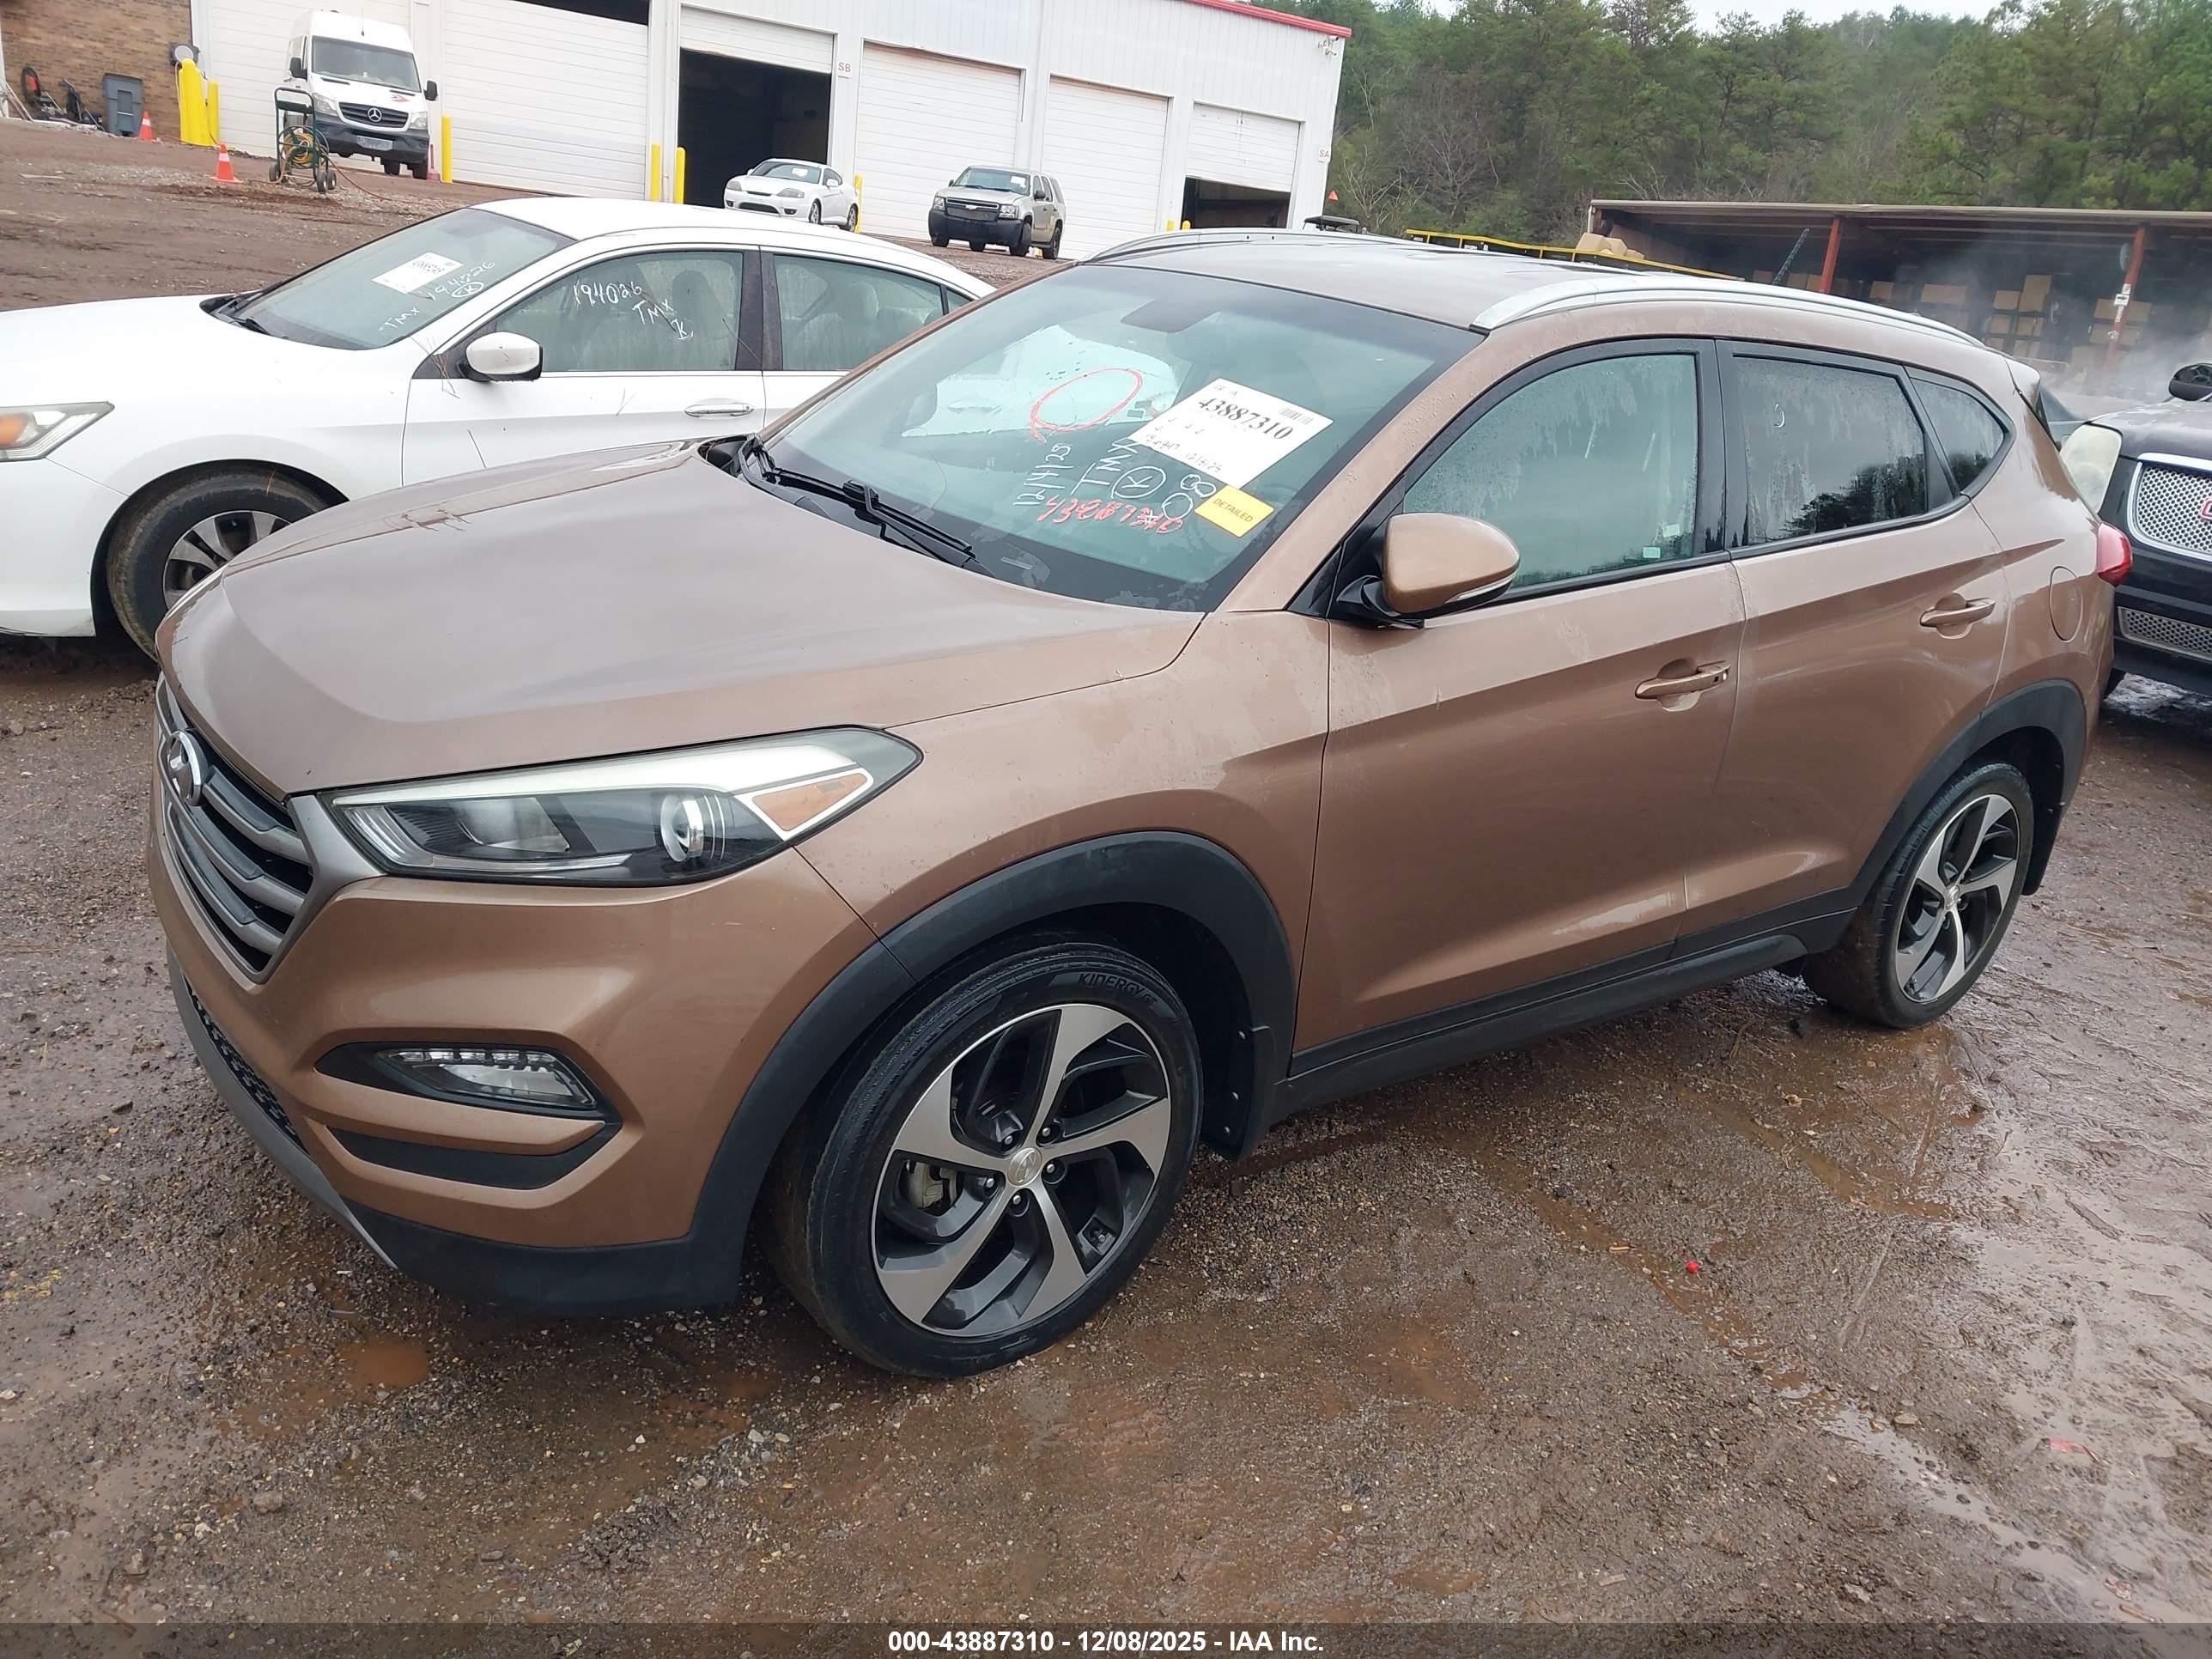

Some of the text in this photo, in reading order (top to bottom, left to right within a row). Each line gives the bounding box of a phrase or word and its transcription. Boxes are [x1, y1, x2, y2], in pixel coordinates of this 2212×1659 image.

[838, 61, 851, 72] SB
[1319, 149, 1329, 158] SA
[573, 281, 642, 307] 194026
[1198, 398, 1294, 440] 43887310
[1070, 436, 1141, 495] TMX
[1212, 498, 1254, 523] DETAILED
[1079, 972, 1146, 996] KINERGY
